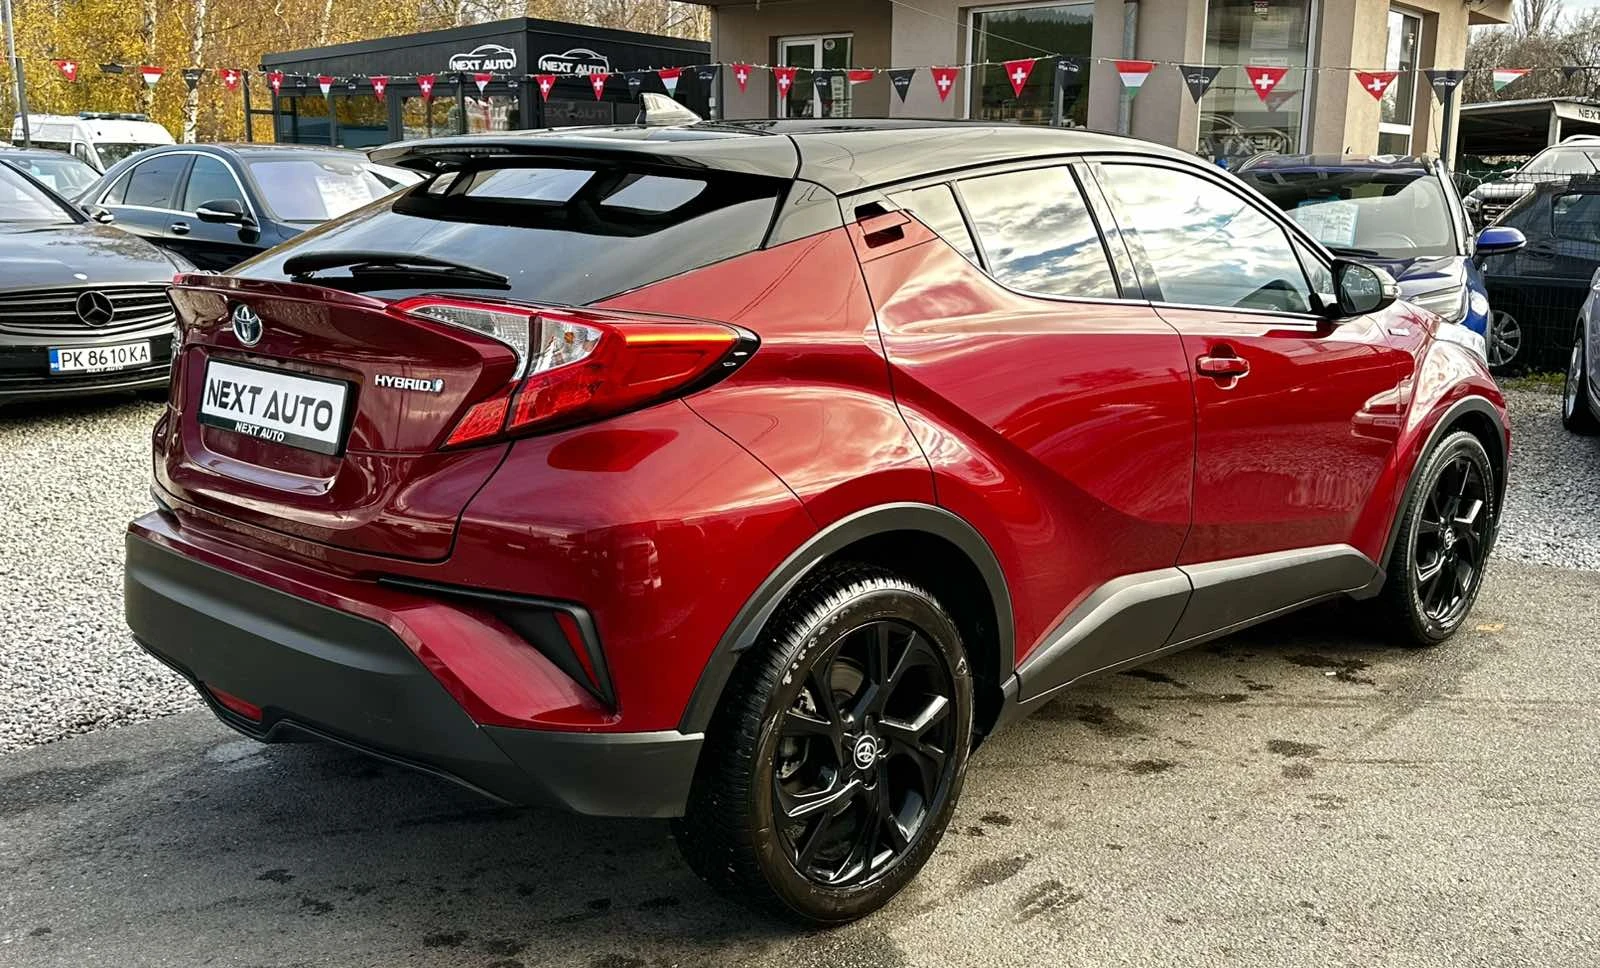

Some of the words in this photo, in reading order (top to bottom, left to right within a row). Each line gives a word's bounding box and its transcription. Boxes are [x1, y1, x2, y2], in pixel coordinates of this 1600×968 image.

[452, 59, 481, 71] NEXT
[482, 58, 514, 70] AUTO
[541, 60, 574, 73] NEXT
[574, 62, 607, 75] AUTO
[61, 351, 84, 368] PK
[88, 348, 127, 366] 8610
[129, 345, 148, 362] KA
[206, 377, 264, 415] NEXT
[262, 390, 334, 432] AUTO
[234, 422, 261, 437] NEXT
[259, 427, 285, 442] AUTO
